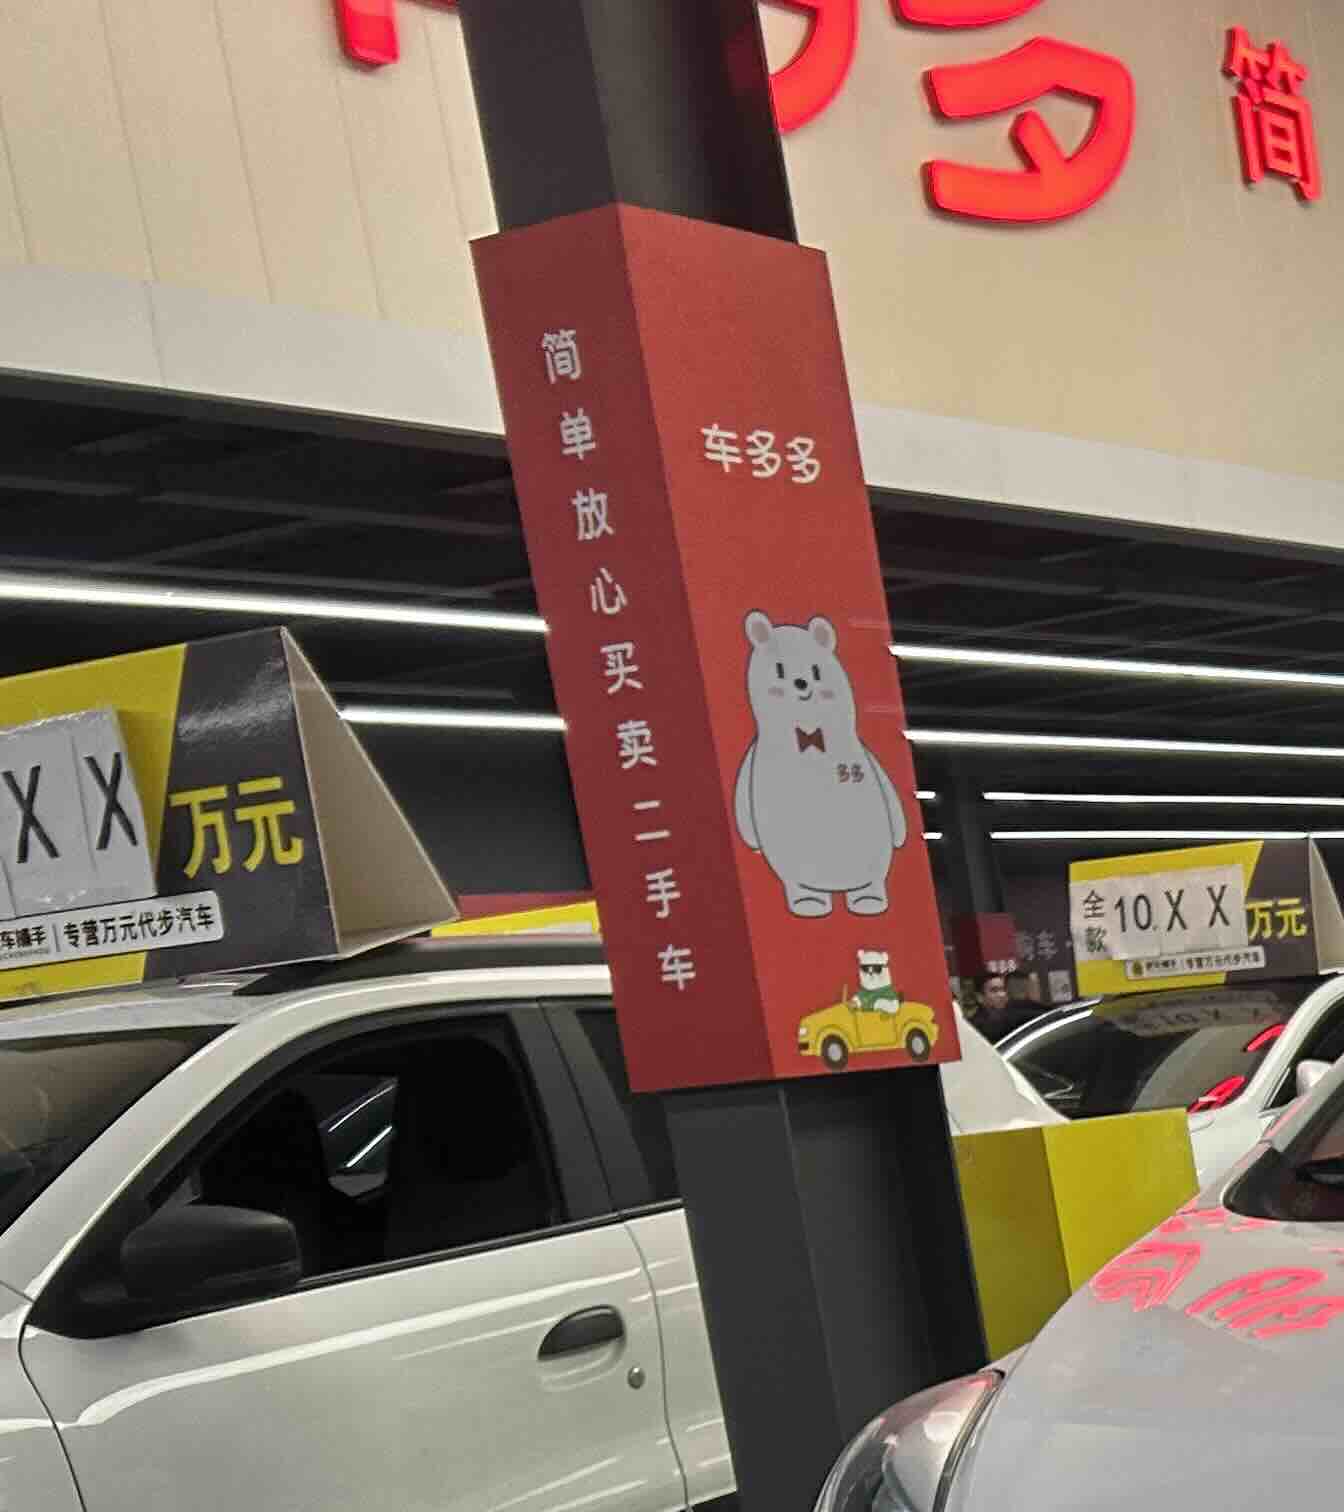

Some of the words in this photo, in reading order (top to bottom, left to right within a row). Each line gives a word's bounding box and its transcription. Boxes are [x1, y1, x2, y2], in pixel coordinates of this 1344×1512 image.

[700, 422, 822, 485] 车多多
[541, 328, 697, 991] 简单放心买卖二手车
[836, 762, 865, 783] 多多
[169, 775, 305, 879] 万元
[62, 903, 216, 948] 专营万元代步汽车
[1083, 889, 1108, 953] 全款
[1246, 897, 1308, 940] 万元
